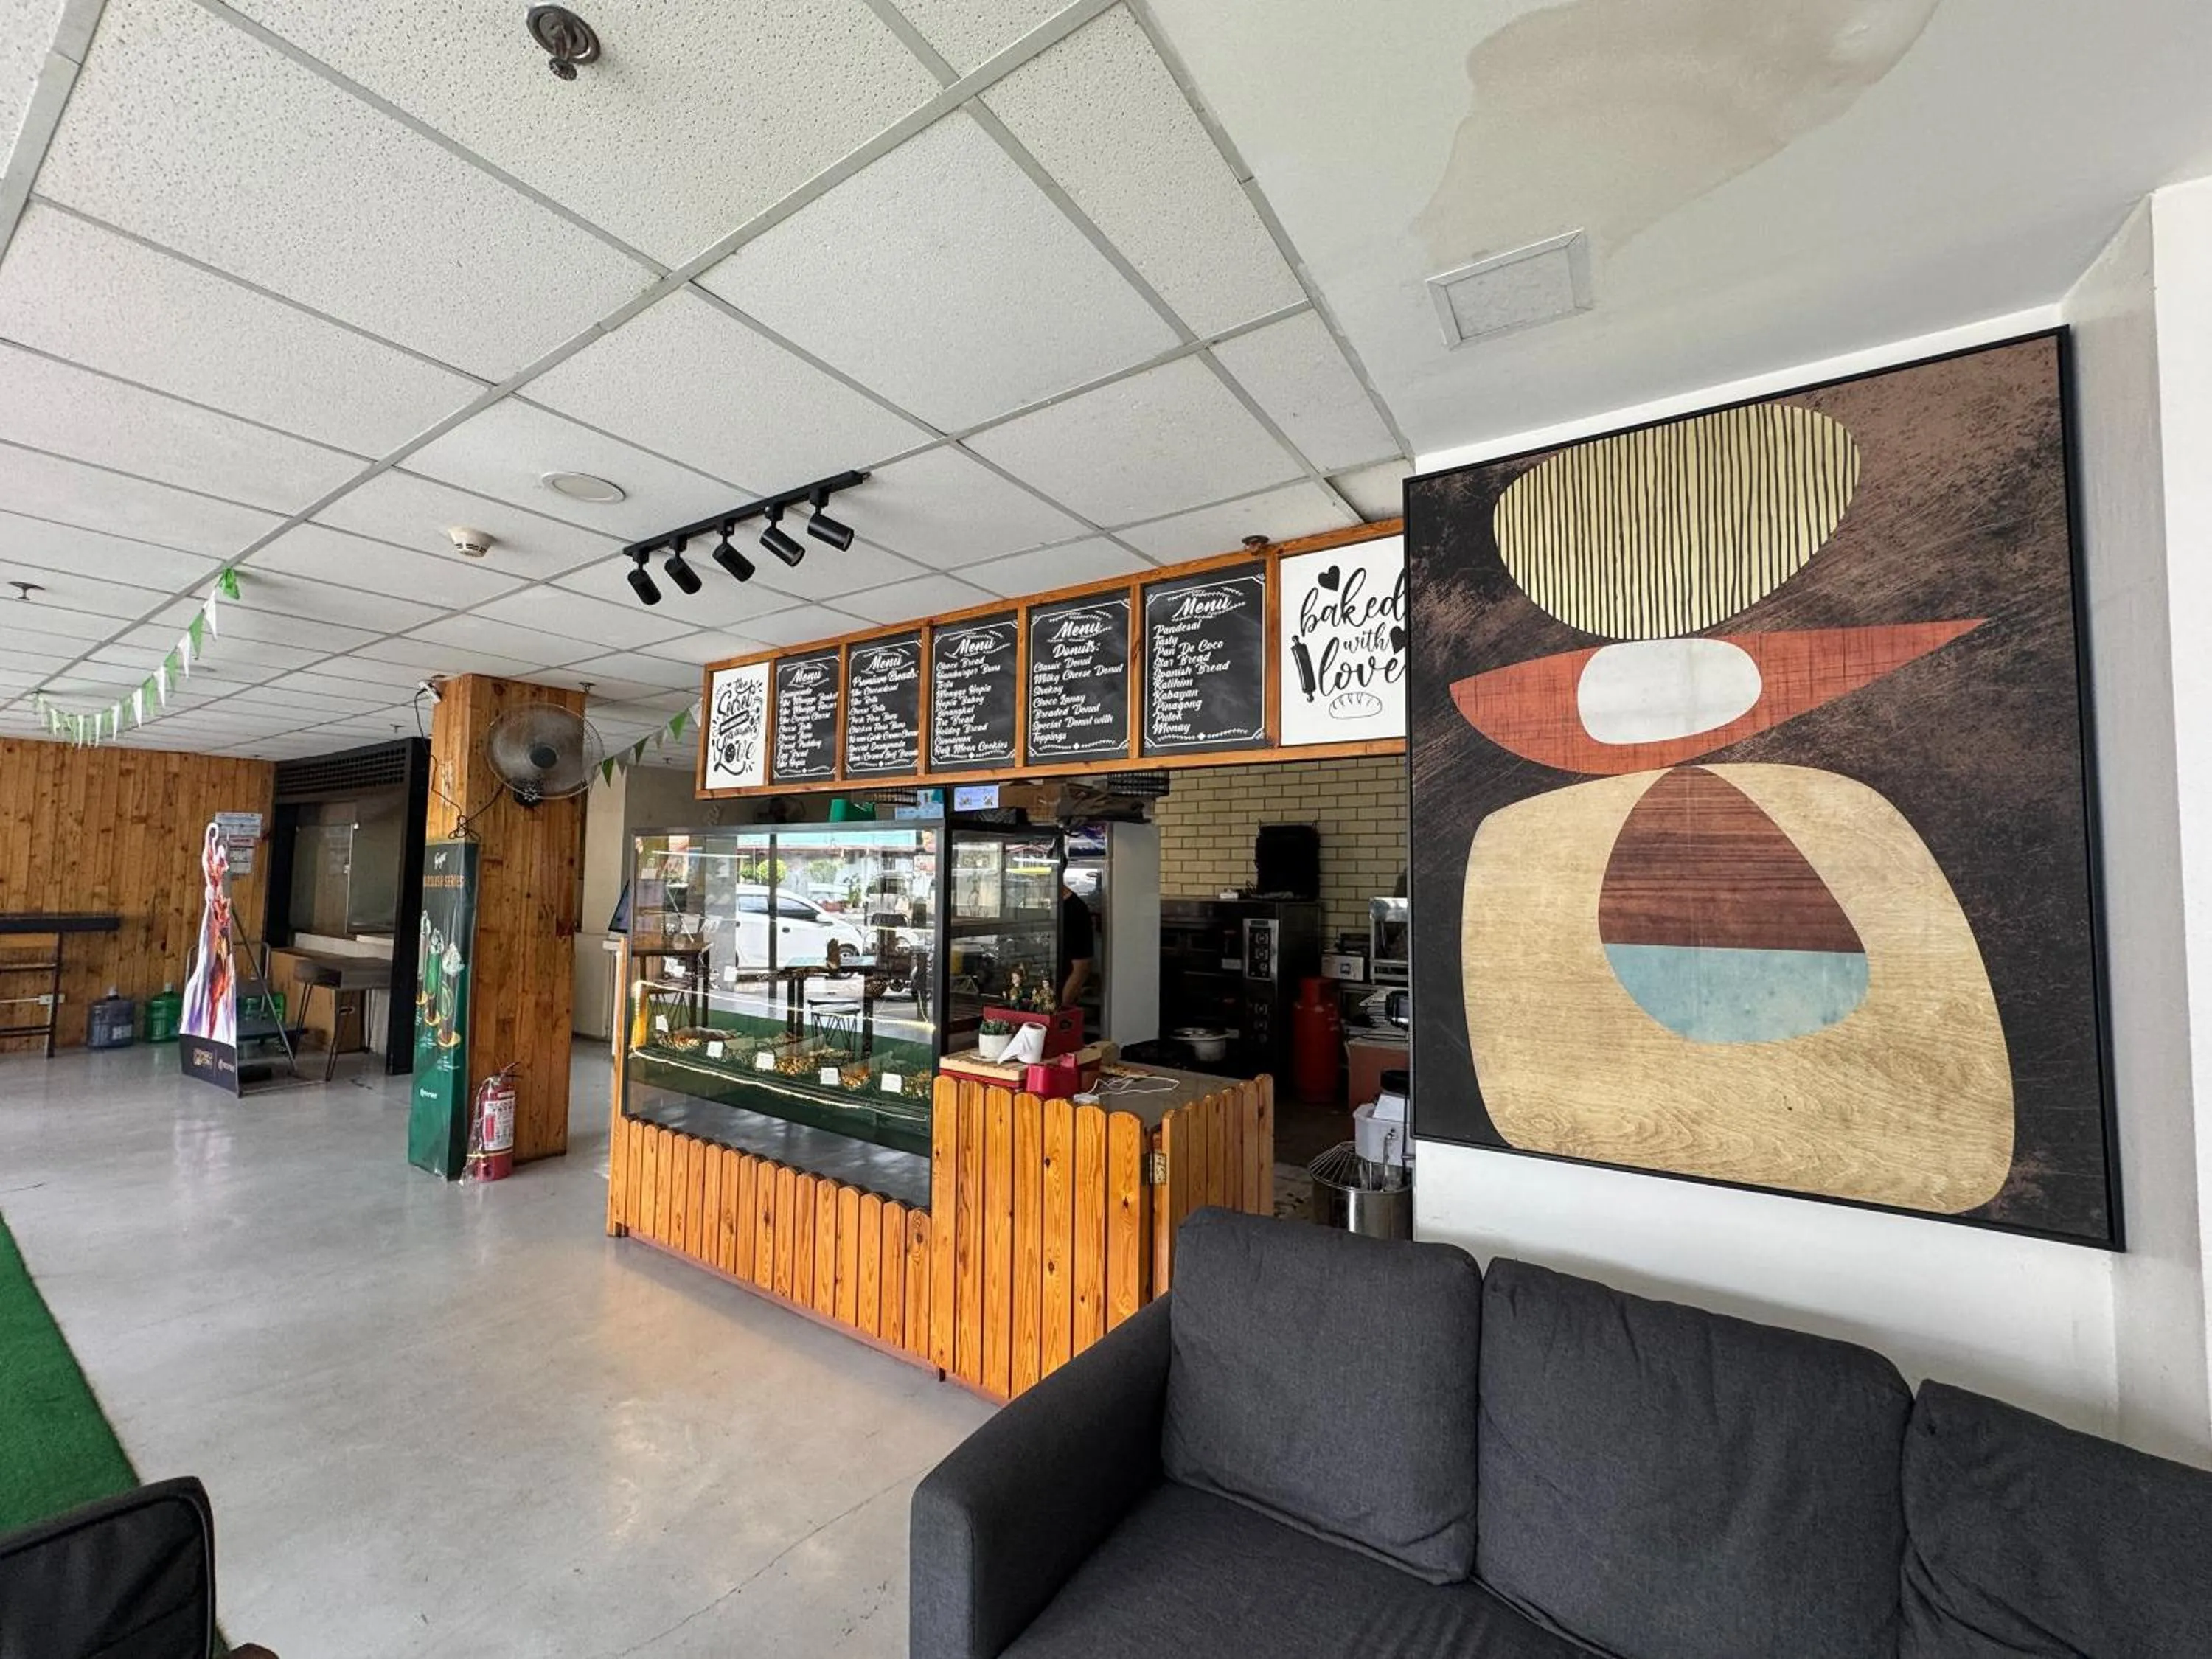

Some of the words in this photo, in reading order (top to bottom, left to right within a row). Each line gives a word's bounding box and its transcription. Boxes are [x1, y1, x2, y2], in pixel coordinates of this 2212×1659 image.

[1172, 597, 1230, 619] Menu
[1300, 567, 1405, 637] baked
[1054, 621, 1101, 639] Menu
[1153, 620, 1201, 636] Pandesal
[1153, 635, 1178, 647] Tasty
[1343, 622, 1390, 654] with
[953, 639, 995, 655] Menu
[1053, 640, 1101, 658] Donuts:
[1153, 647, 1175, 658] Pan
[1179, 642, 1194, 656] De
[1198, 639, 1224, 653] Coco
[866, 655, 902, 672] Menu
[961, 656, 985, 668] Bread
[1034, 661, 1061, 673] Classic
[1065, 656, 1092, 669] Donut
[1153, 657, 1174, 669] Star
[1178, 652, 1211, 666] Bread
[1318, 636, 1405, 697] love
[790, 669, 821, 684] Menu
[981, 664, 1001, 674] Buns
[1034, 673, 1060, 684] Milky
[1062, 670, 1091, 681] Cheese
[1094, 664, 1124, 677] Donut
[1153, 666, 1192, 679] Spanish
[1196, 661, 1231, 675] Bread
[852, 675, 886, 687] Premium
[1153, 678, 1193, 691] Kalihim
[1033, 697, 1058, 708] Choco
[1153, 689, 1199, 702] Kabayan
[1033, 708, 1069, 720] Breaded
[1072, 703, 1101, 715] Donut
[1153, 700, 1203, 714] Pinagong
[950, 714, 975, 726] Bread
[1033, 719, 1062, 732] Special
[1065, 716, 1093, 728] Donut
[1094, 714, 1113, 724] with
[1153, 711, 1183, 723] Putok
[963, 723, 988, 734] Bread
[1152, 722, 1191, 735] Monay
[1033, 731, 1067, 744] Toppings
[935, 745, 950, 756] Half
[953, 743, 975, 754] Moon
[978, 740, 1008, 751] Cookies
